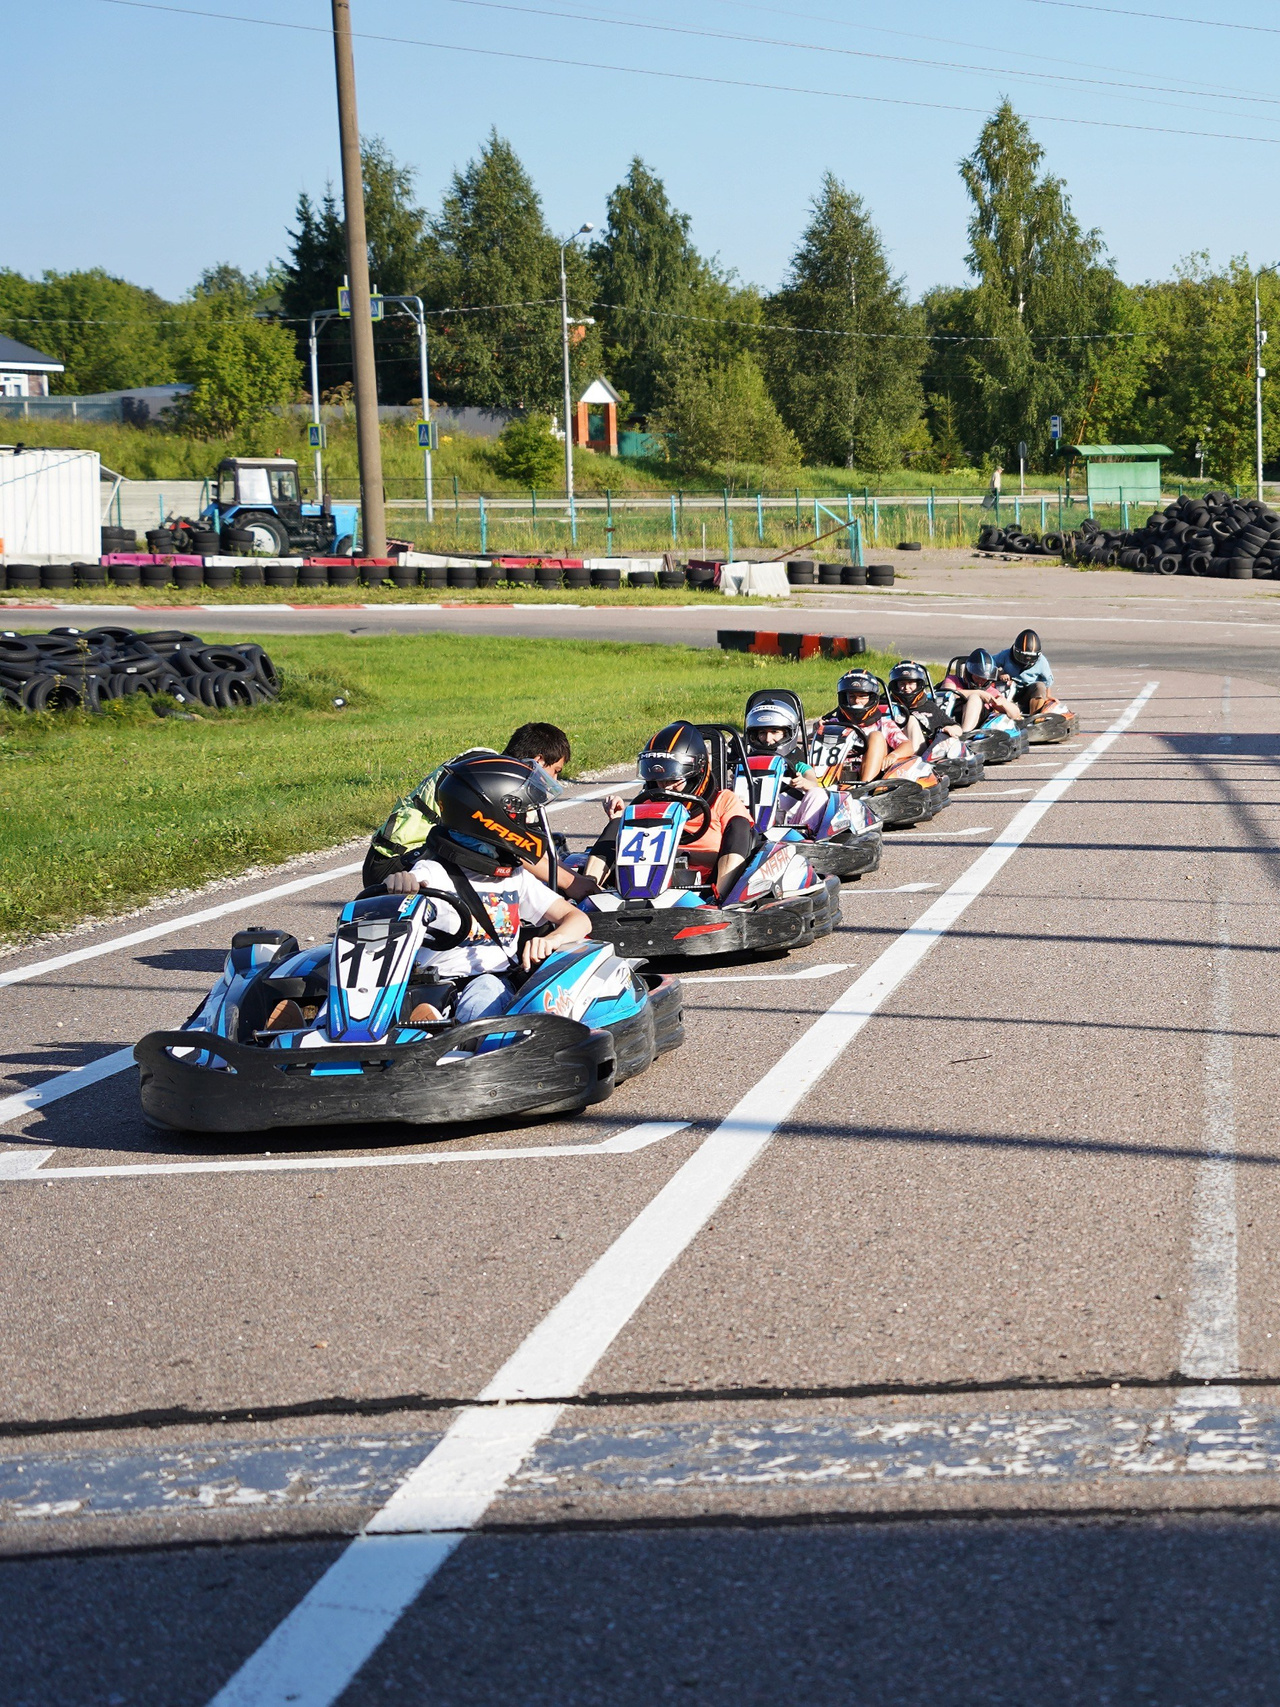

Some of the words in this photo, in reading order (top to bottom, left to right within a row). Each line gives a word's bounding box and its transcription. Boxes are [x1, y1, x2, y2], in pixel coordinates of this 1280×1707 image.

[810, 746, 841, 767] 18
[471, 810, 536, 852] МАЯК
[621, 831, 667, 863] 41
[759, 847, 791, 880] МАЯК
[340, 940, 399, 989] 11
